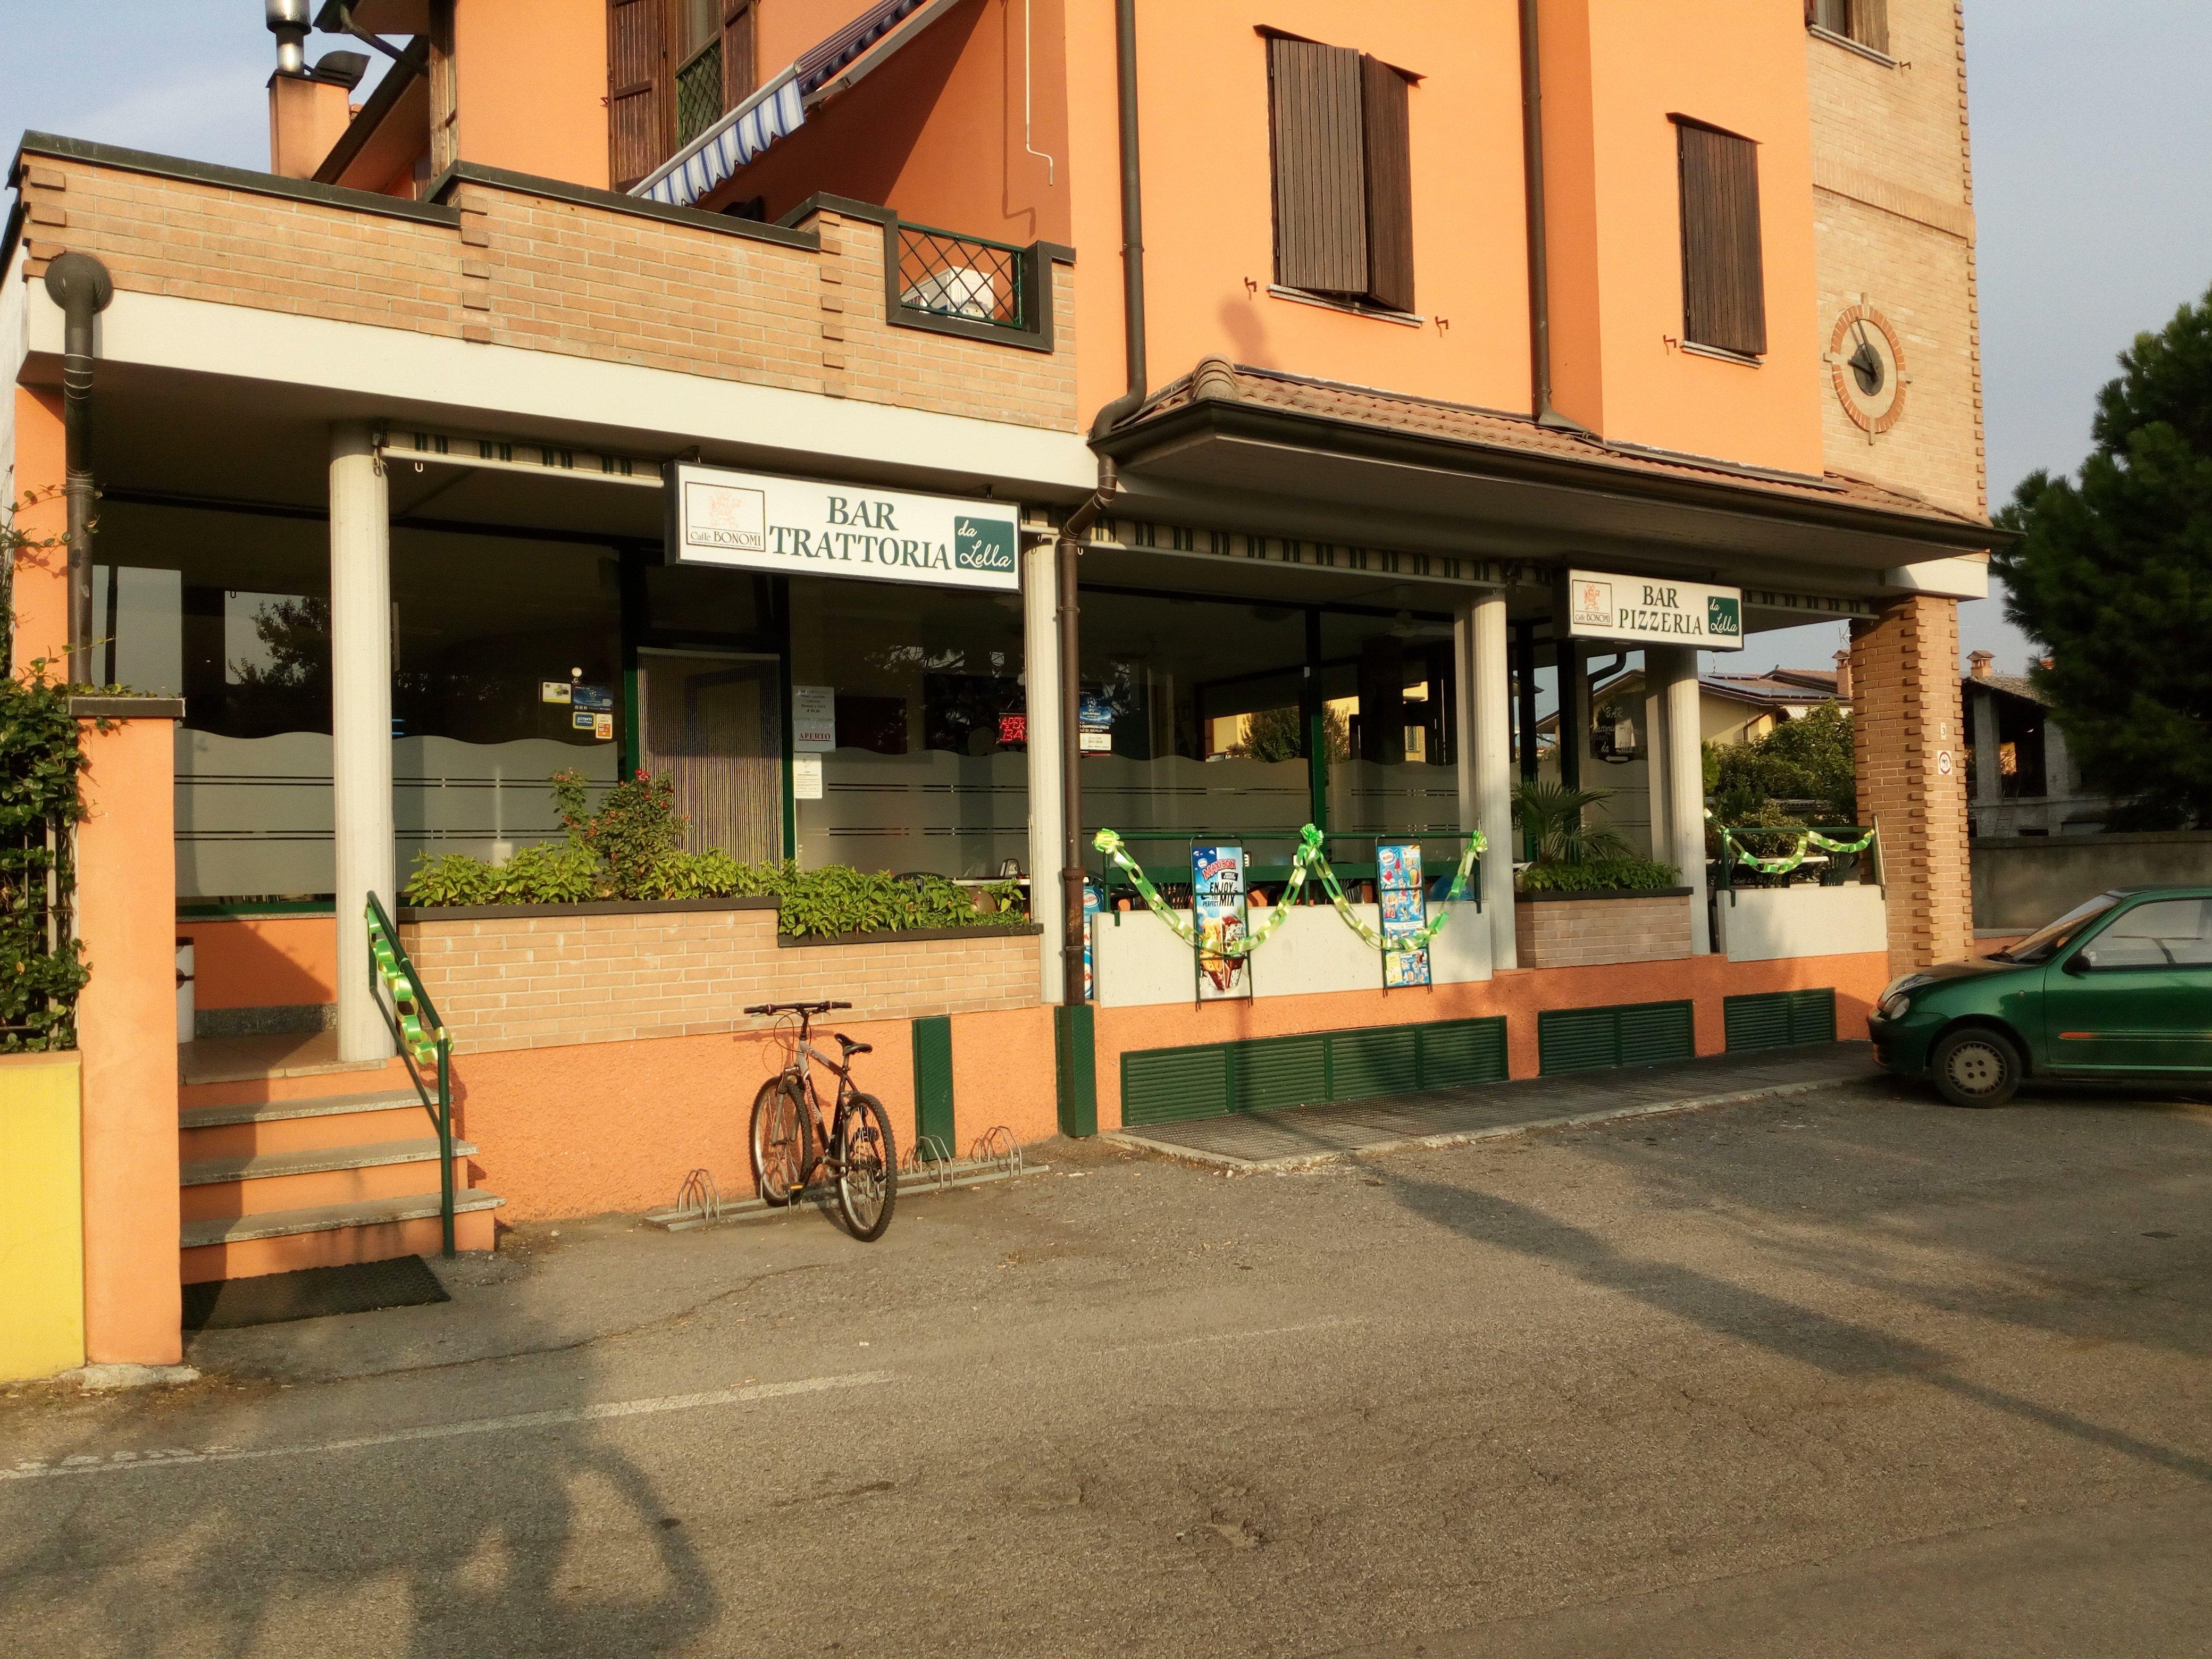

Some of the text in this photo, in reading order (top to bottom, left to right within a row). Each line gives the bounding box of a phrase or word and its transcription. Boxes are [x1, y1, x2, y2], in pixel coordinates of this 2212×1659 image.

[827, 496, 898, 531] BAR
[958, 520, 977, 537] da
[713, 531, 761, 547] BONOMI
[769, 525, 952, 571] TRATTORIA
[959, 539, 1011, 568] Lella
[1642, 585, 1679, 608] BAR
[1709, 599, 1720, 610] da
[1586, 613, 1611, 623] BONOMI
[1619, 608, 1703, 635] PIZZERIA
[1711, 614, 1738, 633] Lella
[1605, 707, 1623, 718] BAR
[1000, 729, 1027, 741] BA
[1202, 859, 1236, 881] MAXIBON
[1210, 882, 1233, 893] ENJOY
[1219, 894, 1235, 907] MIX
